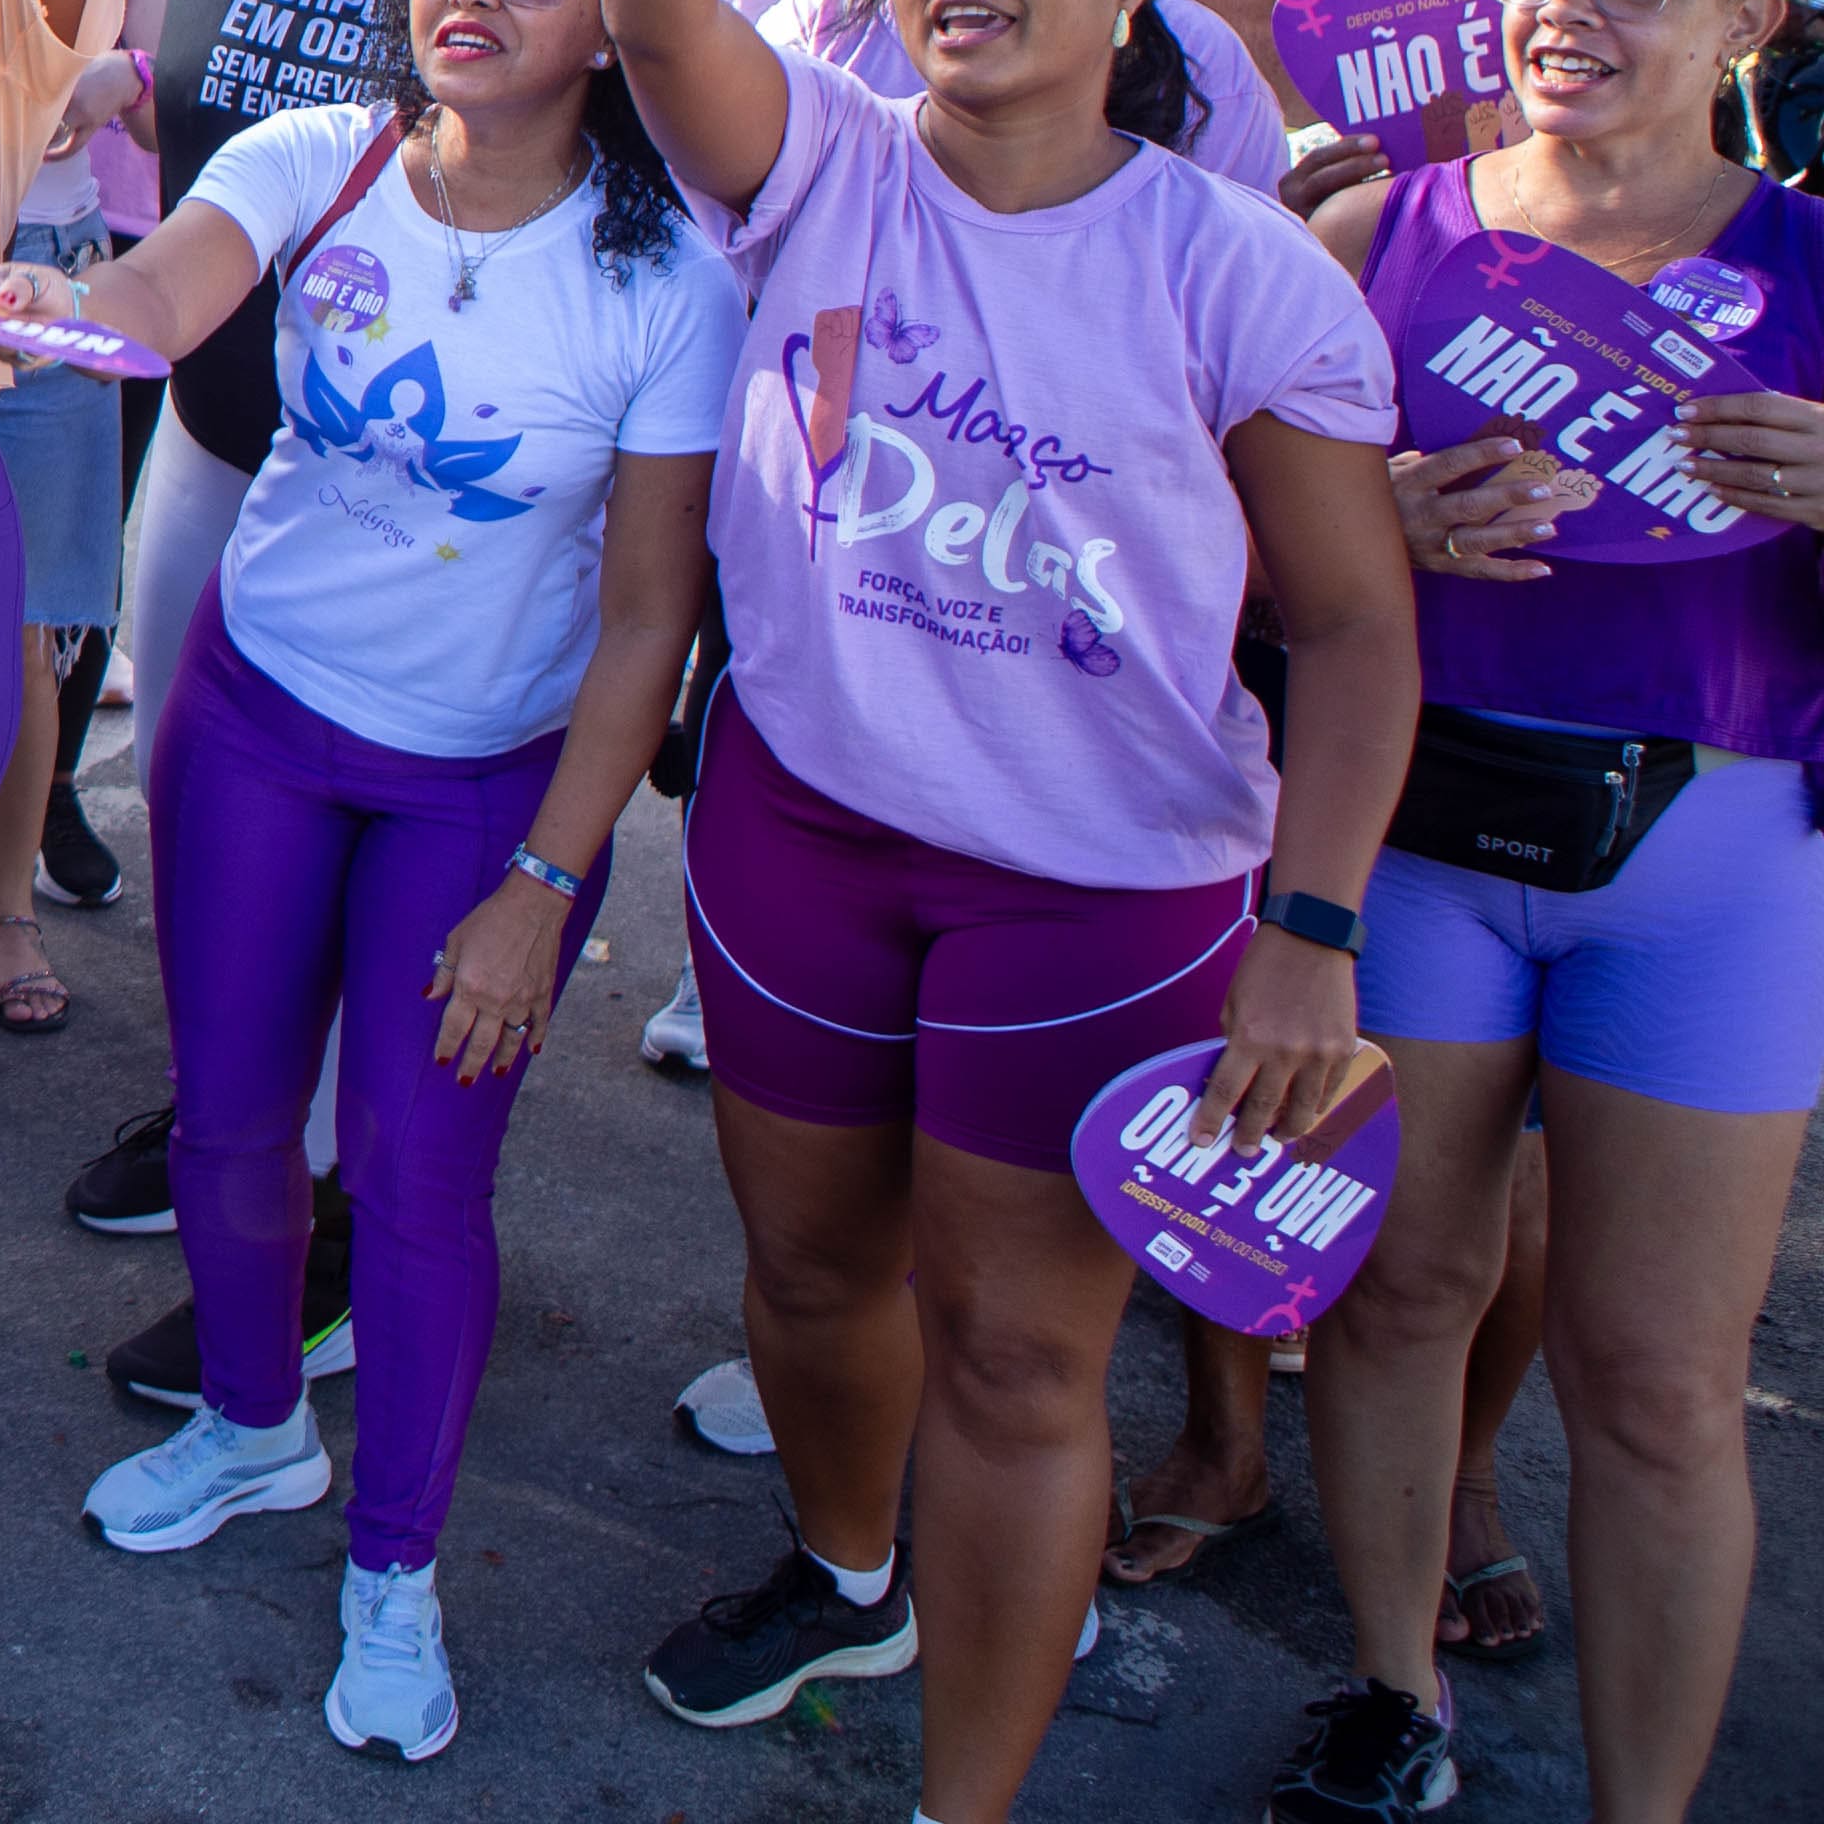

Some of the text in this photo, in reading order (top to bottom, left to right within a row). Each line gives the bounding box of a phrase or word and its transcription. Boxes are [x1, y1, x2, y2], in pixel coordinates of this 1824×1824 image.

[1346, 7, 1394, 29] DEPOIS
[1395, 0, 1414, 17] DO
[200, 75, 237, 111] DE
[207, 44, 271, 86] SEM
[1336, 1, 1501, 126] NÃO É
[302, 272, 384, 315] NÃO É NÃO
[1653, 283, 1758, 328] NÃO É NÃO
[1520, 296, 1677, 396] DEPOIS DO NÃO, TUDO
[1424, 314, 1651, 463] NÃO É
[883, 371, 1113, 491] Março
[836, 410, 1126, 635] Delas
[837, 592, 1032, 658] TRANSFORMAÇÃO!
[857, 569, 1004, 625] FORÇA, VOZ E
[1476, 833, 1555, 865] SPORT
[1119, 1178, 1289, 1276] DEPOIS TUDO ASSÉDIO!
[1254, 1160, 1378, 1253] NÃO
